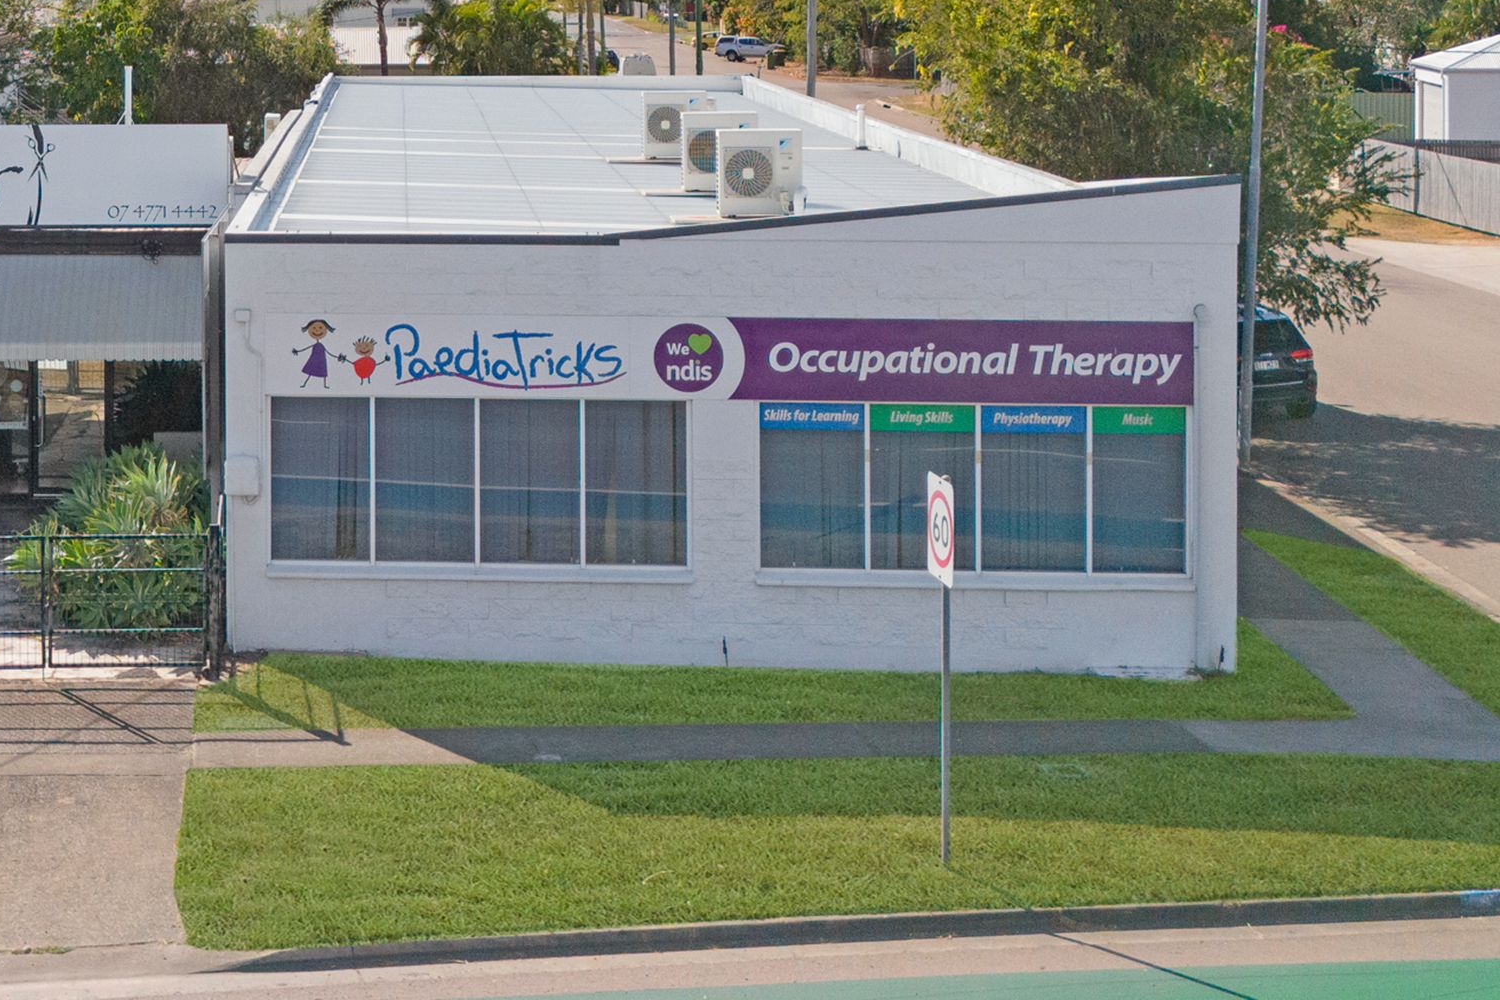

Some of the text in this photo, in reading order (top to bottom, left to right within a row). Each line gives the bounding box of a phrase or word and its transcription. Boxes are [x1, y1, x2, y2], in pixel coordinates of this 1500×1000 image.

[107, 204, 218, 222] 07 4771 4442
[666, 342, 690, 356] We
[666, 359, 713, 382] ndis
[768, 341, 1183, 386] Occupational Therapy
[763, 409, 860, 425] Skills for Learning
[890, 410, 954, 425] Living Skills
[993, 412, 1073, 428] Physiotherapy
[1121, 413, 1154, 426] Music
[933, 511, 949, 549] 60
